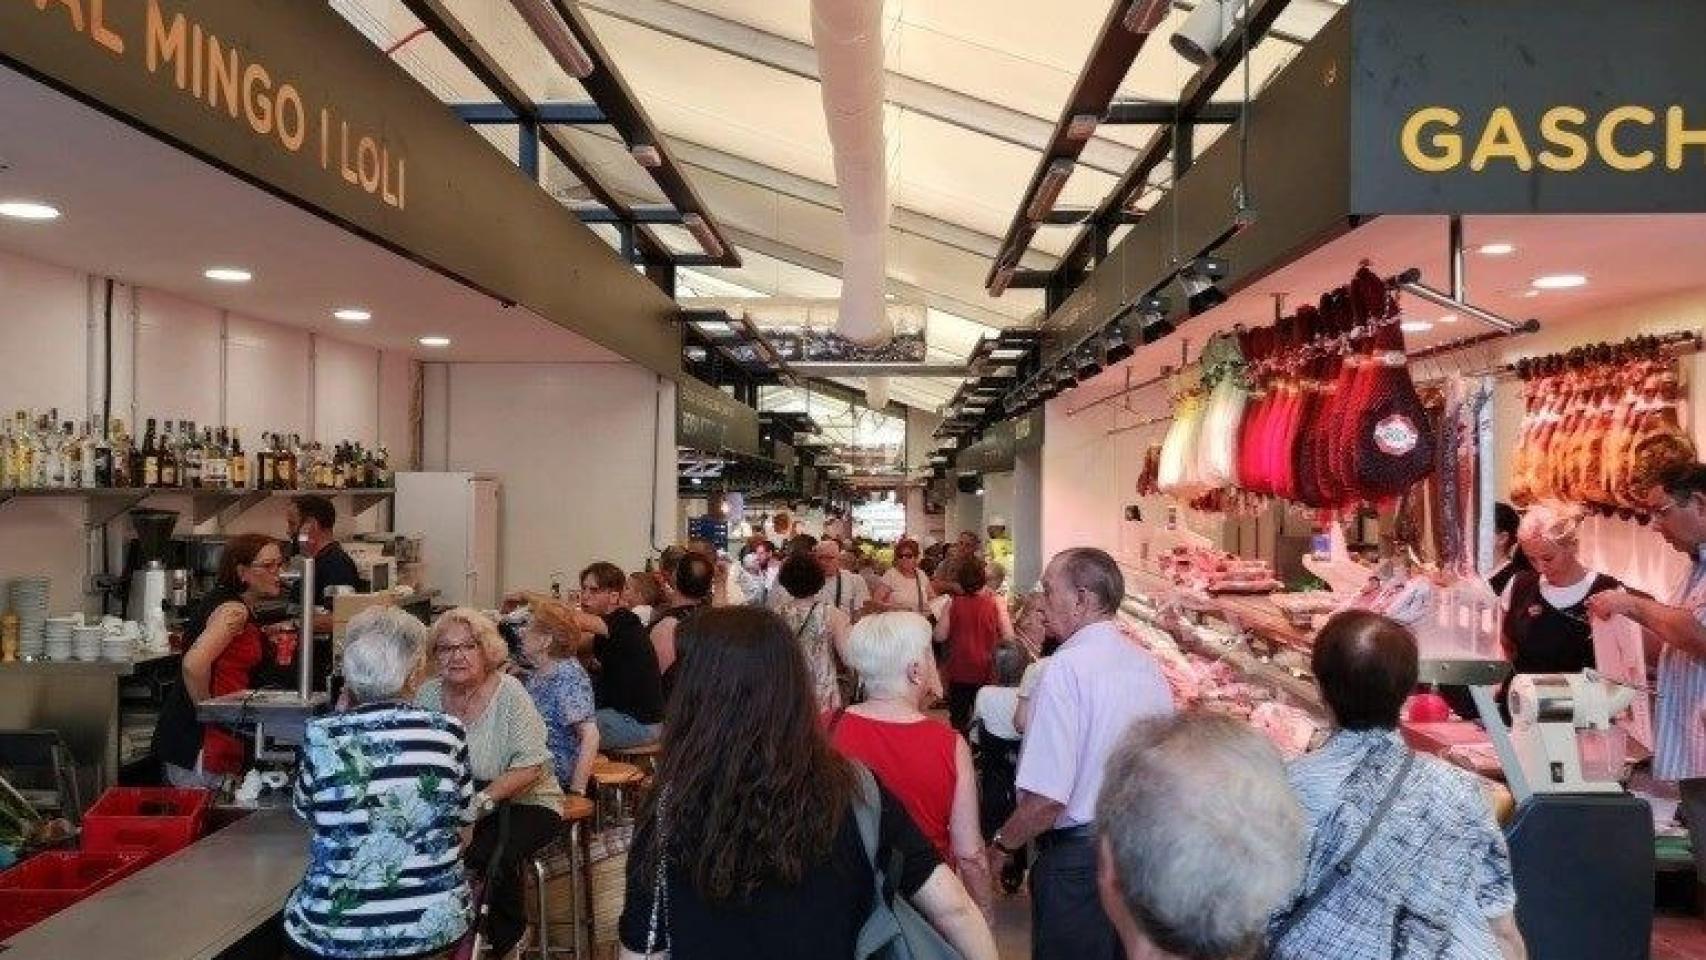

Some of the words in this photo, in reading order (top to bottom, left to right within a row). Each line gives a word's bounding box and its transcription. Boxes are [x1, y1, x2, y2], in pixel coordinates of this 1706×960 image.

[35, 0, 124, 54] L
[146, 0, 305, 151] MINGO
[341, 121, 404, 210] LOLI
[1401, 105, 1706, 172] GASCH
